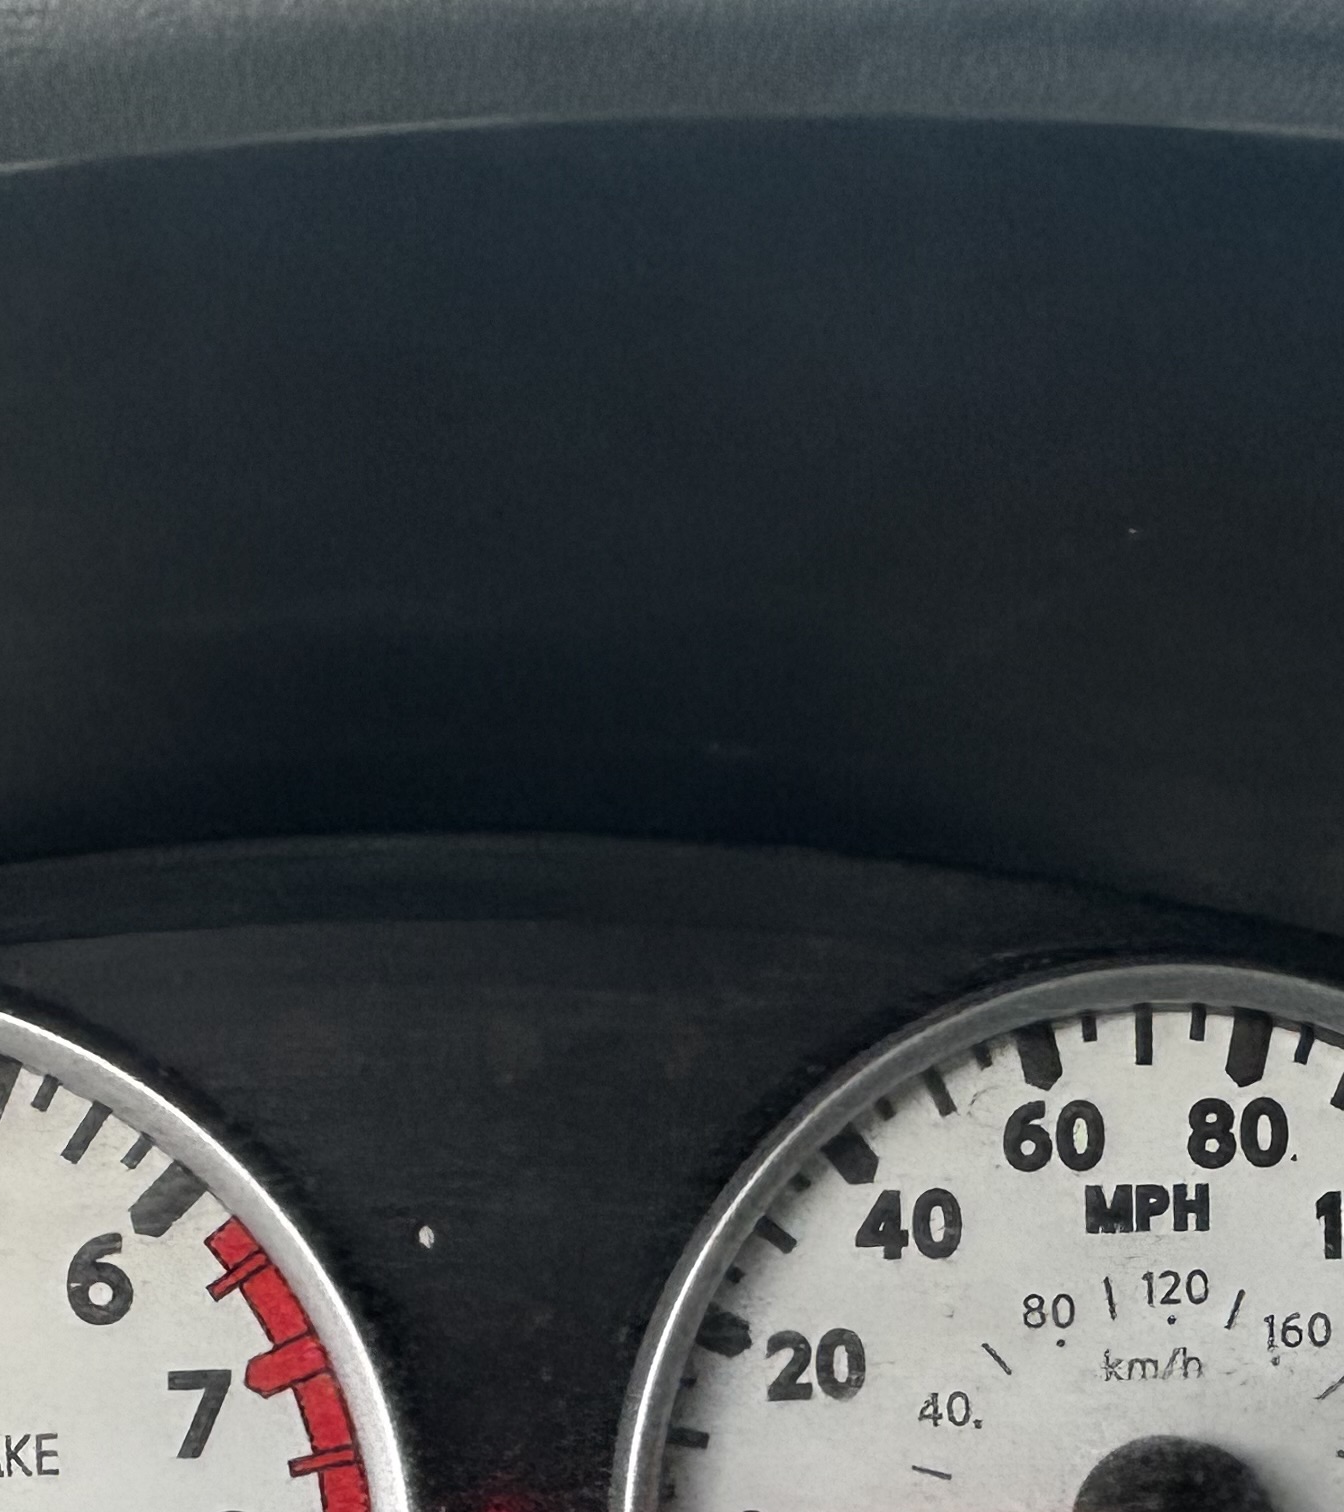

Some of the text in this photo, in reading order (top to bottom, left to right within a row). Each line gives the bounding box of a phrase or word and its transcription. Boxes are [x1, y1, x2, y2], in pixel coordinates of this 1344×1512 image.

[1003, 1101, 1105, 1172] 60
[1187, 1097, 1289, 1169] 80
[855, 1188, 962, 1260] 40
[1084, 1184, 1210, 1234] MPH
[67, 1233, 133, 1325] 6
[1022, 1294, 1076, 1329] 80
[1142, 1270, 1210, 1306] 120
[765, 1328, 866, 1401] 20
[1101, 1347, 1203, 1382] km/h
[1264, 1313, 1332, 1349] 160
[167, 1370, 232, 1459] 7
